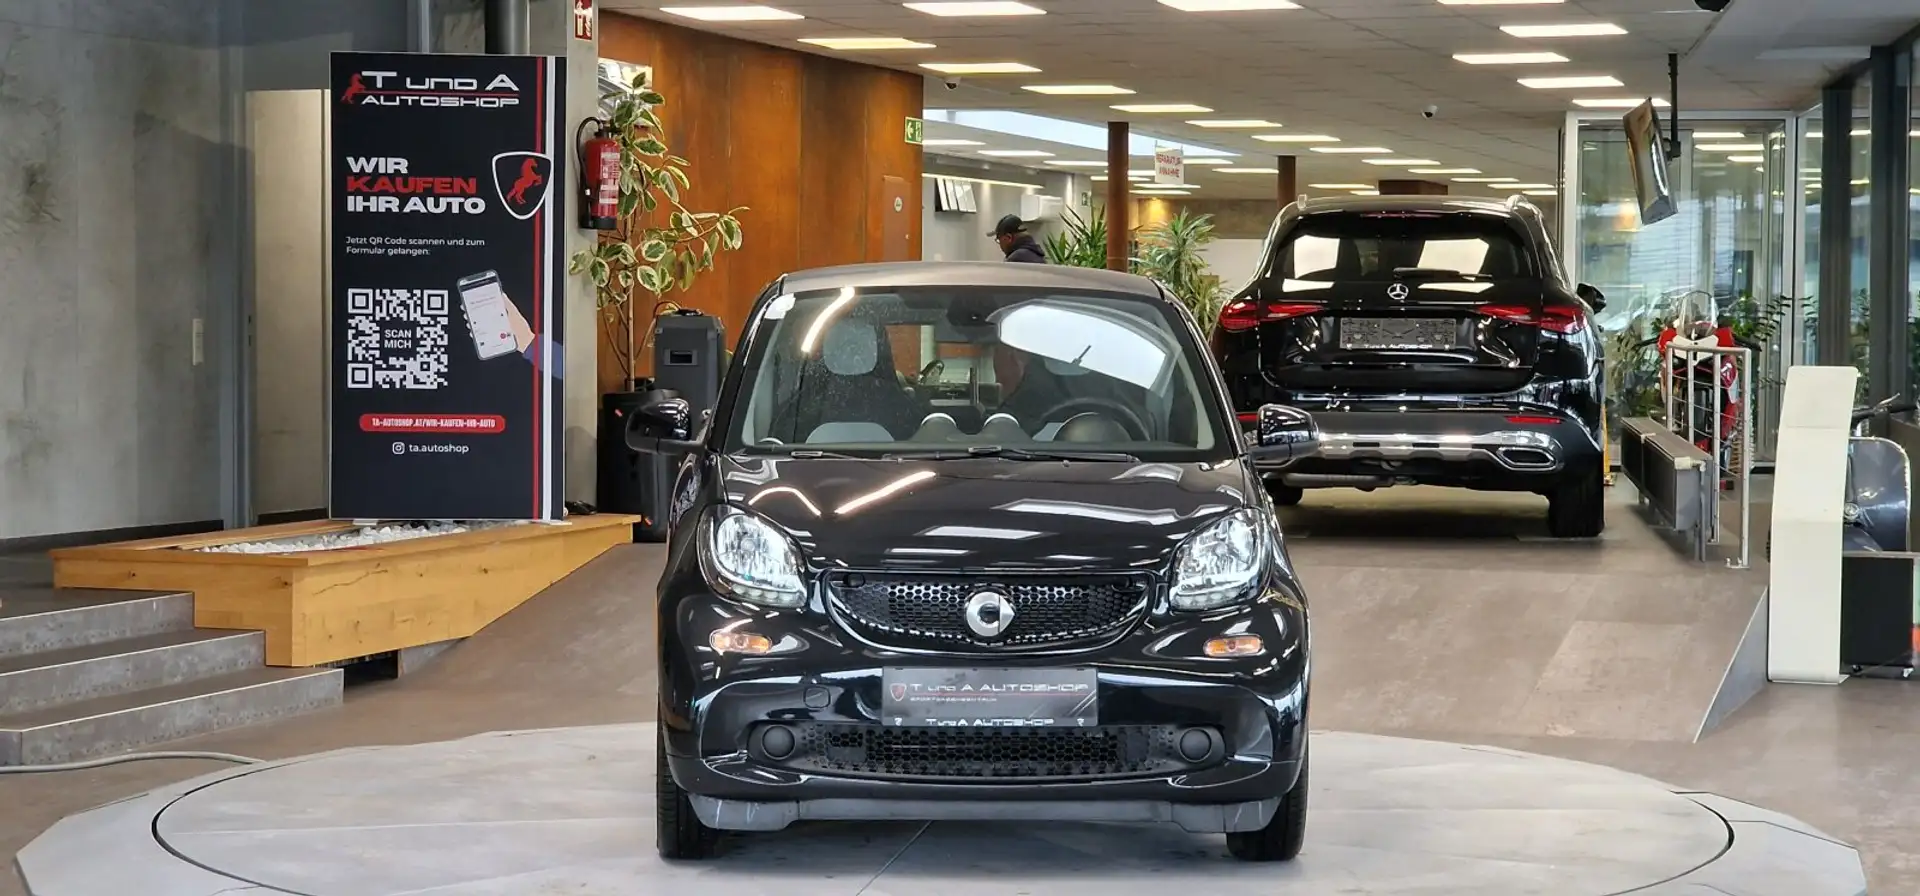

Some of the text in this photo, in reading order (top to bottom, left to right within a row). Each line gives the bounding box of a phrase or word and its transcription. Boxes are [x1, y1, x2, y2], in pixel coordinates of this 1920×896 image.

[361, 71, 397, 89] T
[485, 74, 520, 91] A
[361, 95, 519, 108] AUTOSHOP
[346, 157, 408, 174] WIR
[347, 176, 476, 194] KAUFEN
[347, 196, 486, 215] IHR AUTO
[346, 236, 485, 247] Jetzt QR Code scannen und zum
[346, 246, 385, 255] Formular
[384, 329, 412, 339] SCAN
[384, 339, 412, 349] MICH
[409, 443, 470, 455] ta.autoshop
[910, 684, 923, 692] T
[960, 684, 973, 692] A
[979, 684, 1089, 692] AUTOSHOP
[973, 718, 1055, 727] AUTOSHOP
